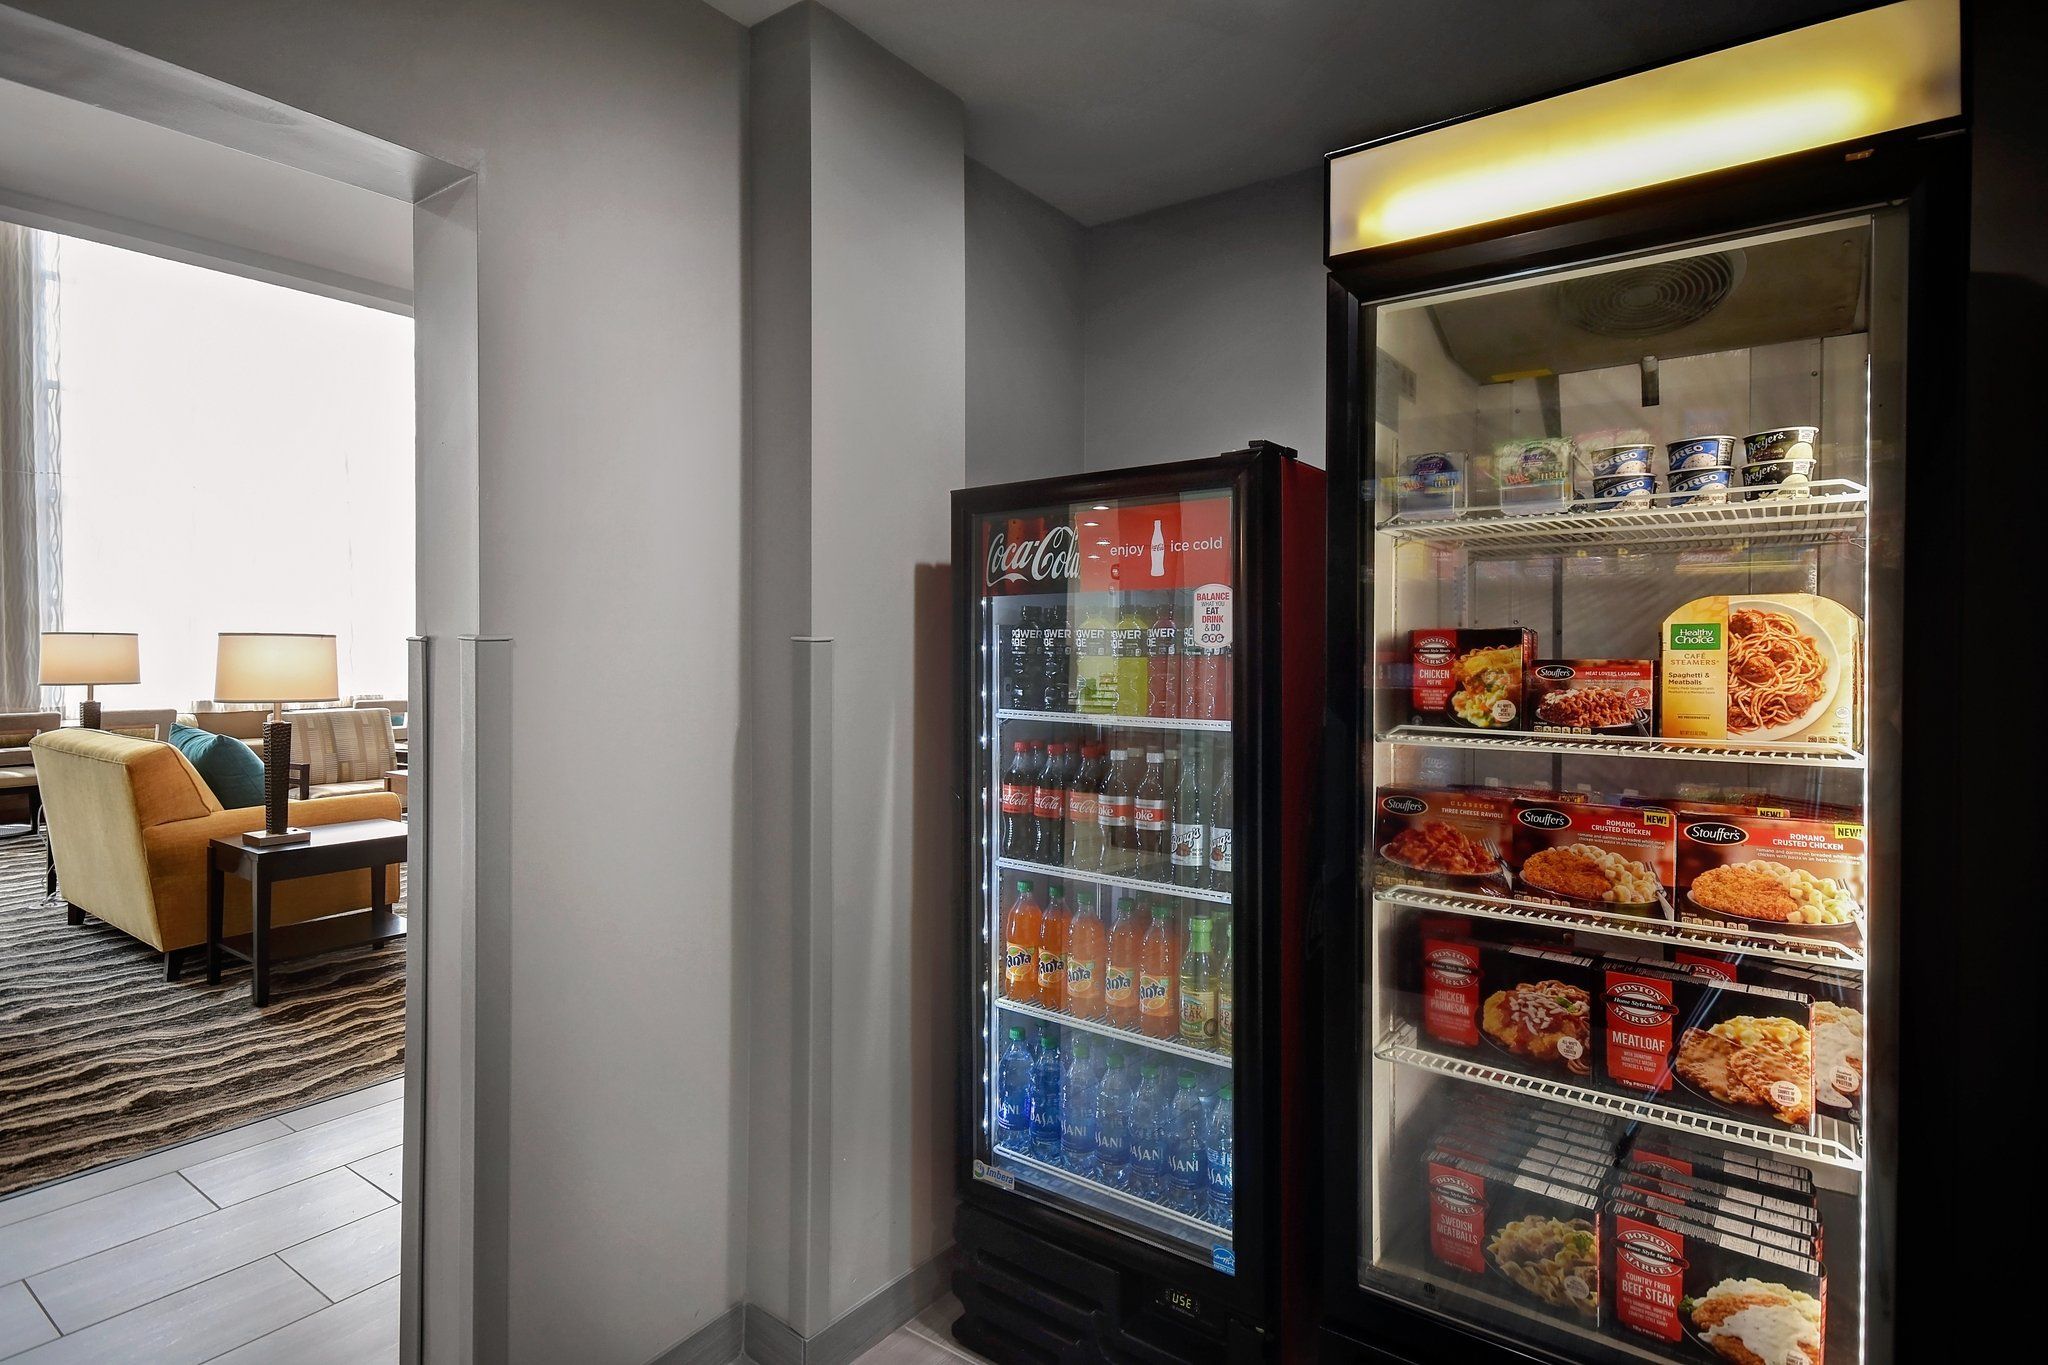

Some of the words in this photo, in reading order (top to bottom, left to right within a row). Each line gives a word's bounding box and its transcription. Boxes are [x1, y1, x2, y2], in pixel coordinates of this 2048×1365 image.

[1599, 452, 1638, 472] OREO
[1603, 480, 1645, 498] OREO
[1675, 474, 1719, 493] OREO
[1110, 544, 1145, 558] enjoy
[1170, 540, 1190, 552] ice
[1193, 536, 1223, 551] cold
[986, 526, 1081, 588] Coca-Cola
[1196, 592, 1231, 601] BALANCE
[1206, 607, 1220, 615] EAT
[1202, 615, 1224, 623] DRINK
[1675, 635, 1716, 644] Choice
[1680, 628, 1714, 637] Healthy
[1684, 652, 1706, 660] CAFÉ
[1419, 669, 1450, 679] CHICKEN
[1540, 668, 1571, 678] Stouffer's
[1633, 690, 1640, 698] 4
[1387, 799, 1422, 812] Stouffer's
[1441, 807, 1459, 815] THREE
[1459, 808, 1480, 817] CHEESE
[1480, 811, 1503, 819] RAVIOLI
[1524, 811, 1565, 826] Stouffer's
[1606, 819, 1636, 828] ROMANO
[1646, 814, 1667, 825] NEW!
[1591, 824, 1621, 833] CRUSTED
[1622, 827, 1651, 837] CHICKEN
[1691, 826, 1741, 841] Stouffer's
[1789, 833, 1825, 842] ROMANO
[1837, 827, 1862, 837] NEW!
[1772, 839, 1808, 848] CRUSTED
[1809, 842, 1844, 851] CHICKEN
[1432, 951, 1472, 966] BOSTON
[1432, 971, 1471, 986] MARKET
[1434, 988, 1465, 1003] CHICKEN
[1614, 984, 1663, 1002] BOSTON
[1430, 998, 1469, 1016] PARMESAN
[1613, 997, 1631, 1005] Home
[1631, 1000, 1645, 1008] Style
[1645, 1002, 1664, 1011] Meals
[1613, 1006, 1663, 1025] MARKET
[1612, 1030, 1666, 1053] MEATLOAF
[1633, 1081, 1656, 1090] PROTEIN
[986, 1167, 1014, 1185] Imbera
[1436, 1176, 1476, 1195] BOSTON
[1437, 1195, 1476, 1214] MARKET
[1440, 1214, 1473, 1233] SWEDISH
[1436, 1222, 1478, 1245] MEATBALLS
[1624, 1232, 1674, 1253] BOSTON
[1624, 1243, 1641, 1252] Home
[1642, 1248, 1656, 1257] Style
[1656, 1253, 1674, 1263] Meals
[1624, 1252, 1673, 1275] MARKET
[1625, 1272, 1653, 1287] COUNTRY
[1653, 1279, 1671, 1292] FRIED
[1172, 1292, 1192, 1309] USE
[1622, 1279, 1644, 1297] BEEF
[1645, 1287, 1675, 1308] STEAK
